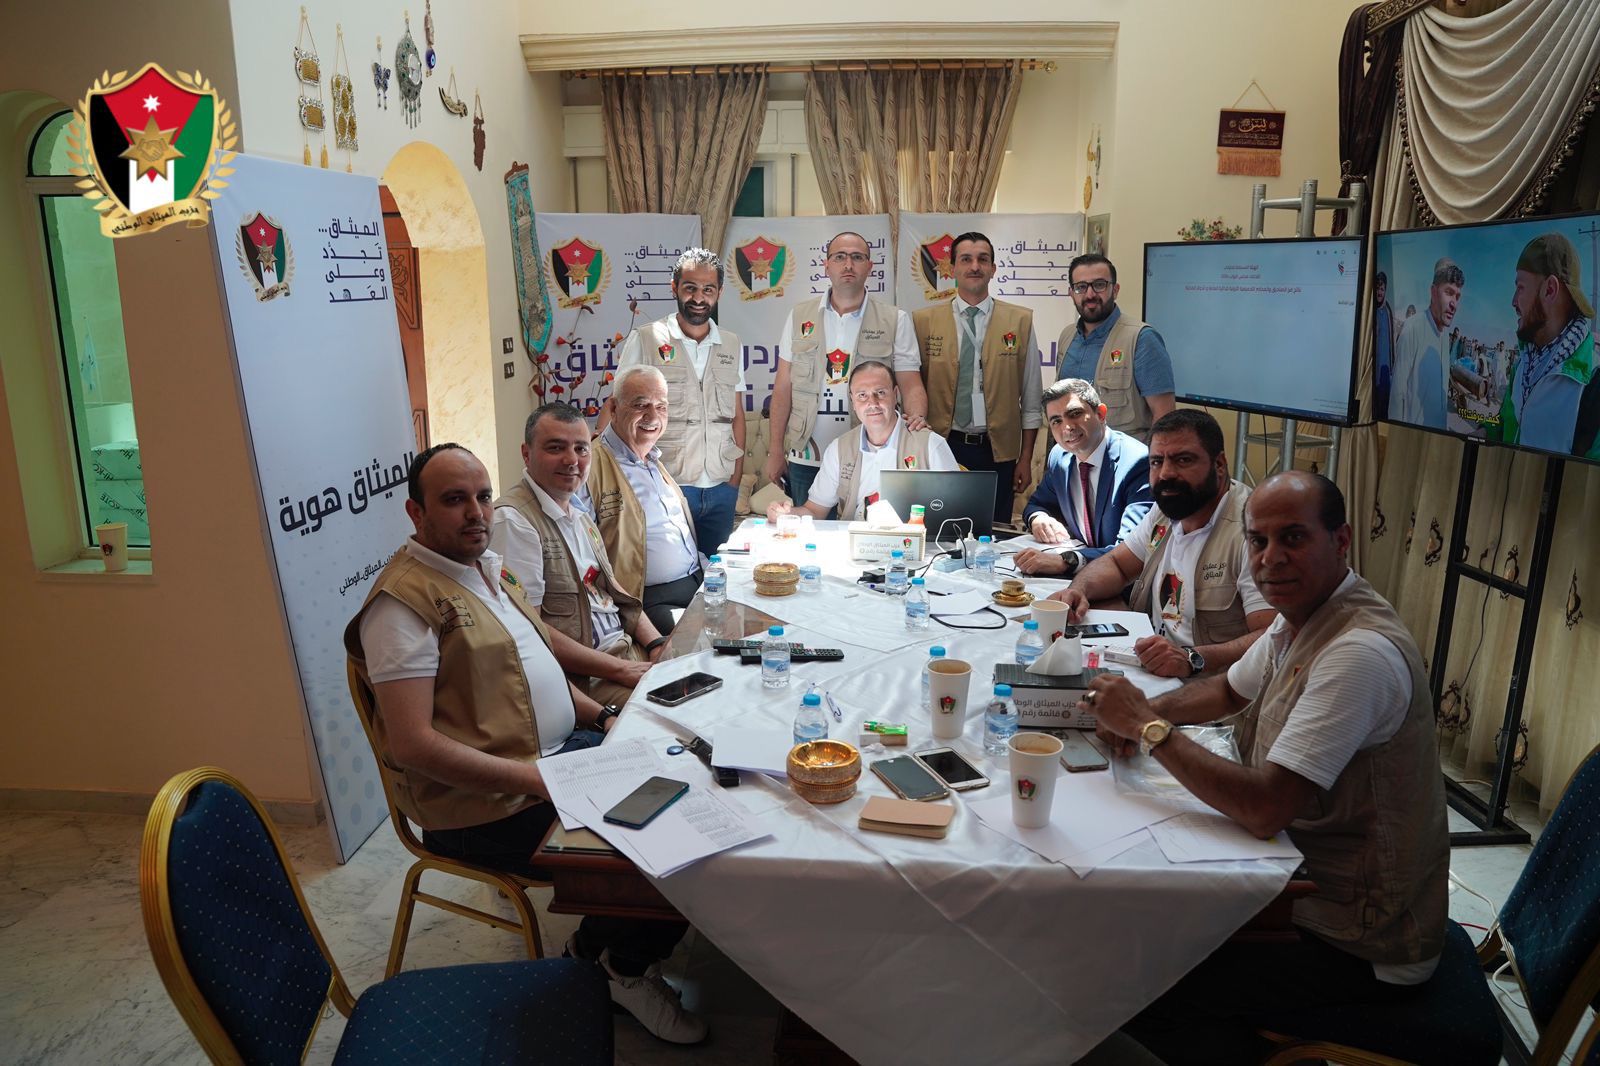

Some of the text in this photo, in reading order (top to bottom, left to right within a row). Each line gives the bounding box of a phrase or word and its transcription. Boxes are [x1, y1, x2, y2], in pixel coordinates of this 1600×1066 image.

[998, 238, 1077, 255] الميثاق...
[325, 264, 385, 283] وعلى
[997, 270, 1068, 283] على
[1485, 412, 1501, 427] كيف
[279, 486, 343, 537] هوية
[1014, 699, 1077, 709] حزب الميثاق الوط
[1021, 709, 1061, 718] قائمة رقم
